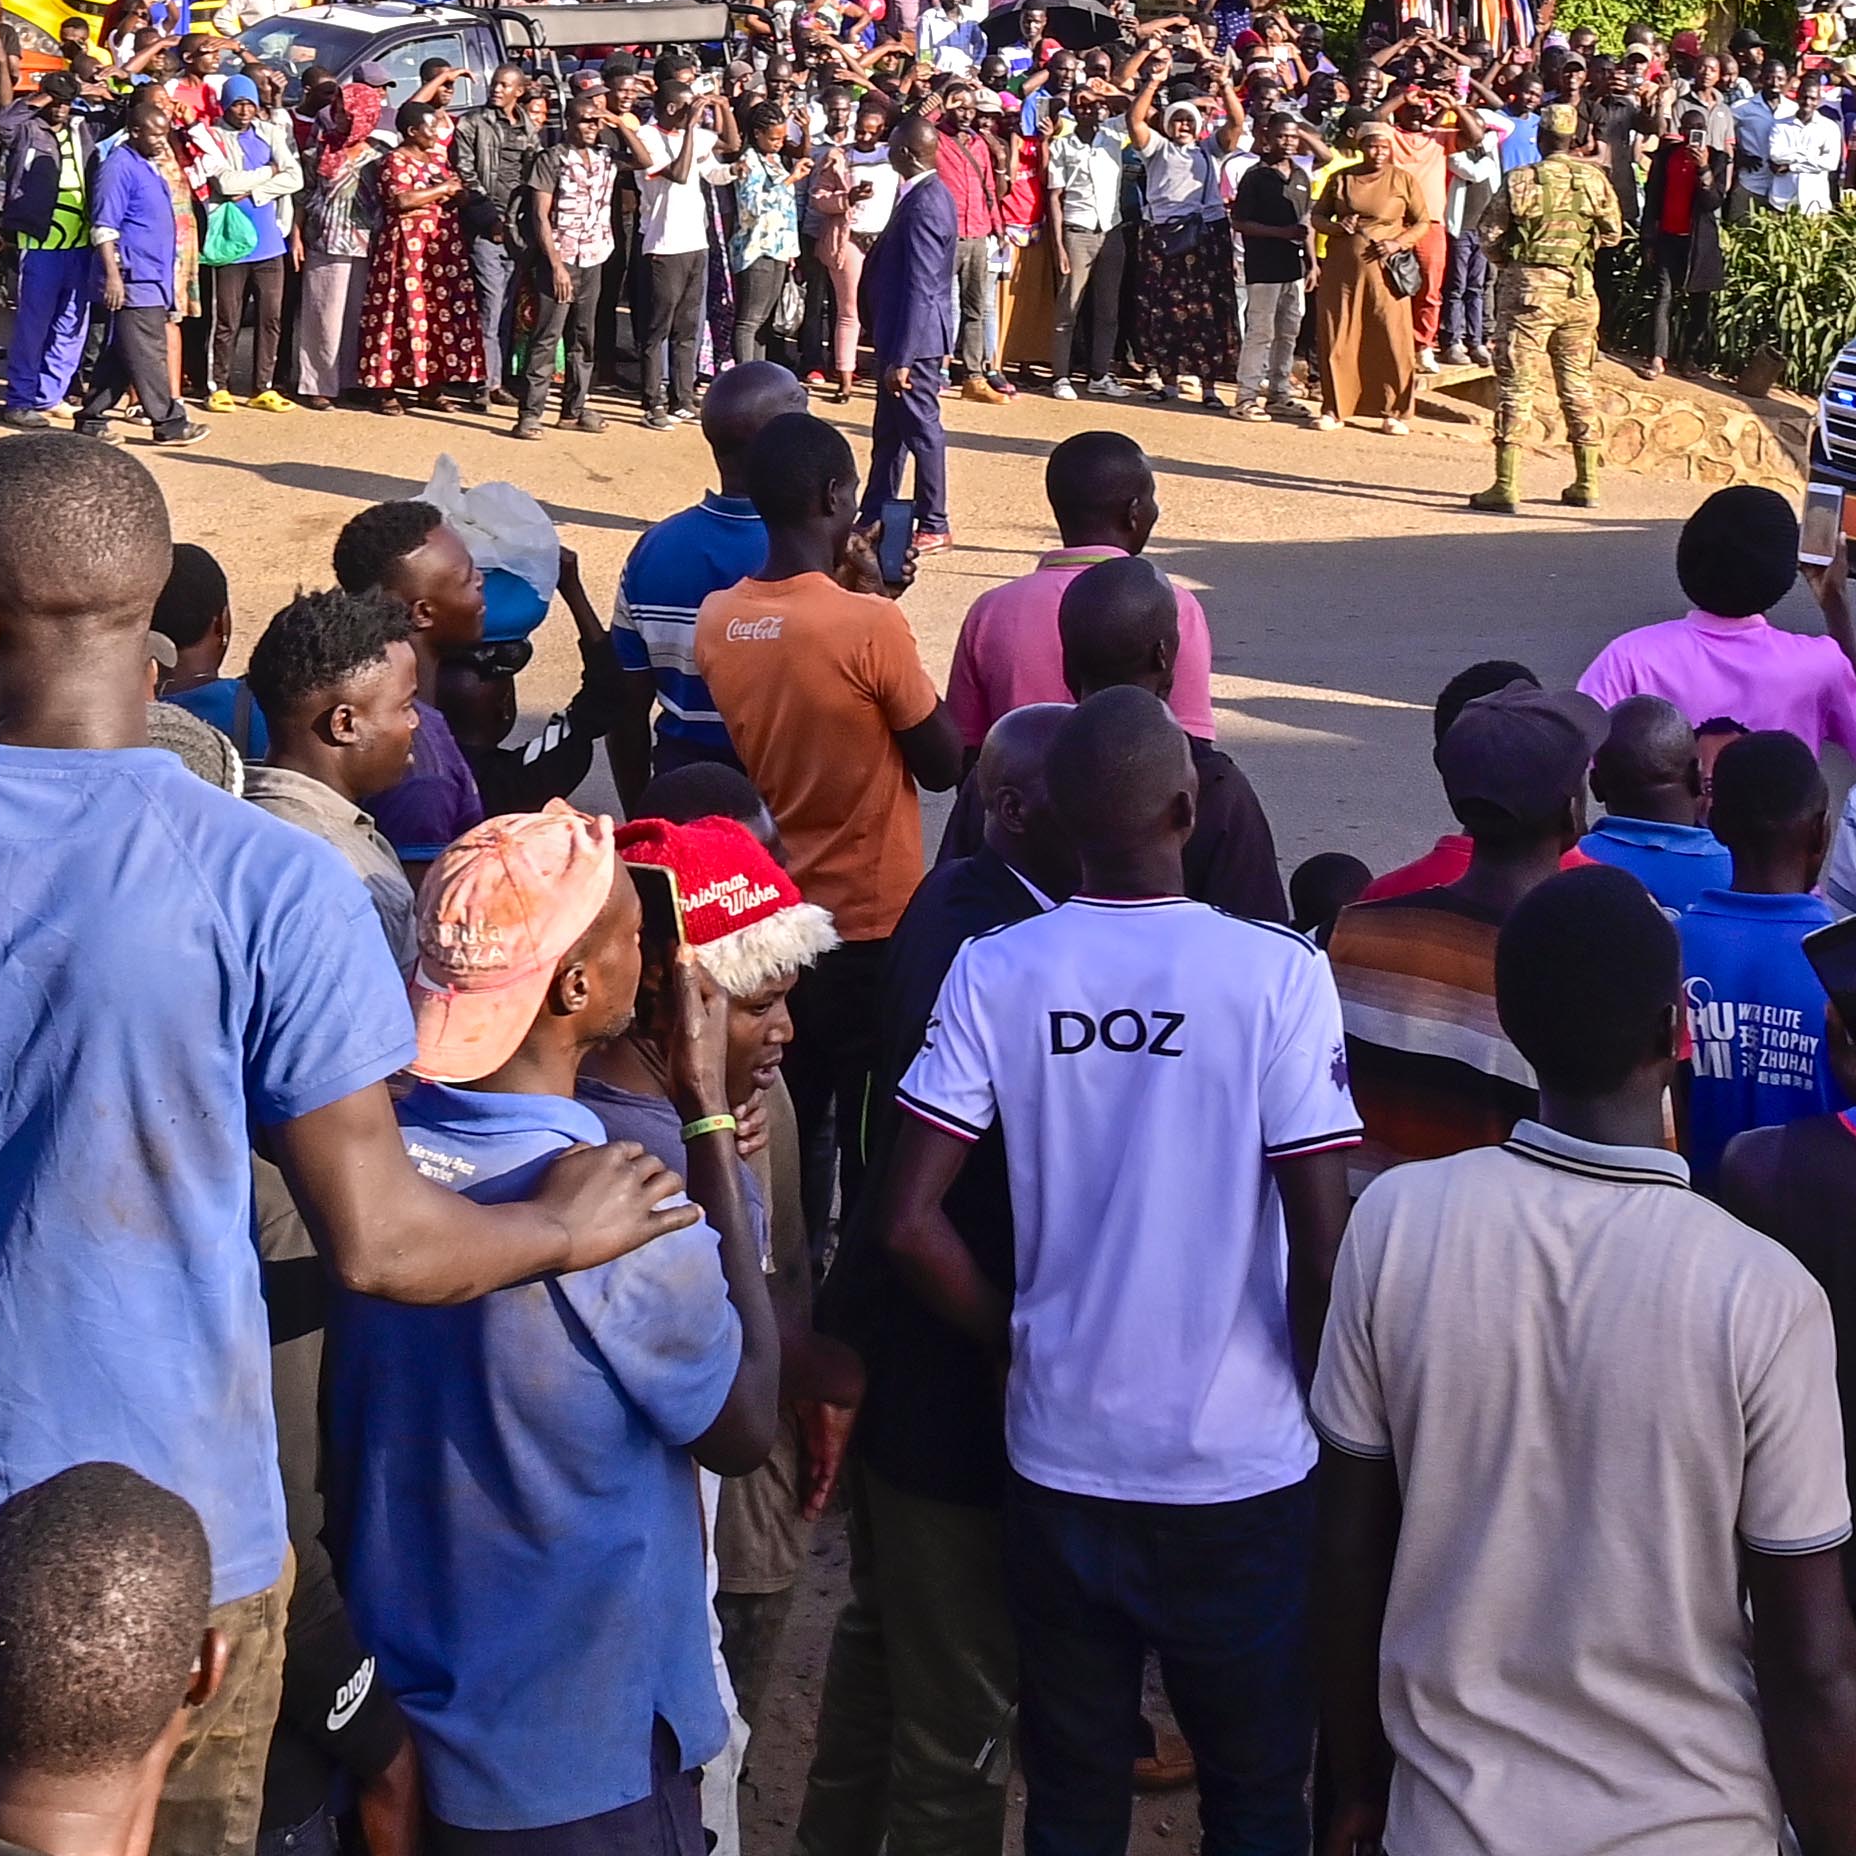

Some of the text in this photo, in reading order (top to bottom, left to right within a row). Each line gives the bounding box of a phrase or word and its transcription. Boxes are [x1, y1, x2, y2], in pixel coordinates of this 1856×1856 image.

[678, 873, 749, 912] hristmas
[719, 883, 780, 916] Wishes
[1048, 1009, 1186, 1057] DOZ
[1763, 1005, 1803, 1030] ELITE
[1761, 1026, 1819, 1056] TROPHY
[1758, 1048, 1813, 1076] ZHUHAI
[335, 1658, 371, 1711] DIOR
